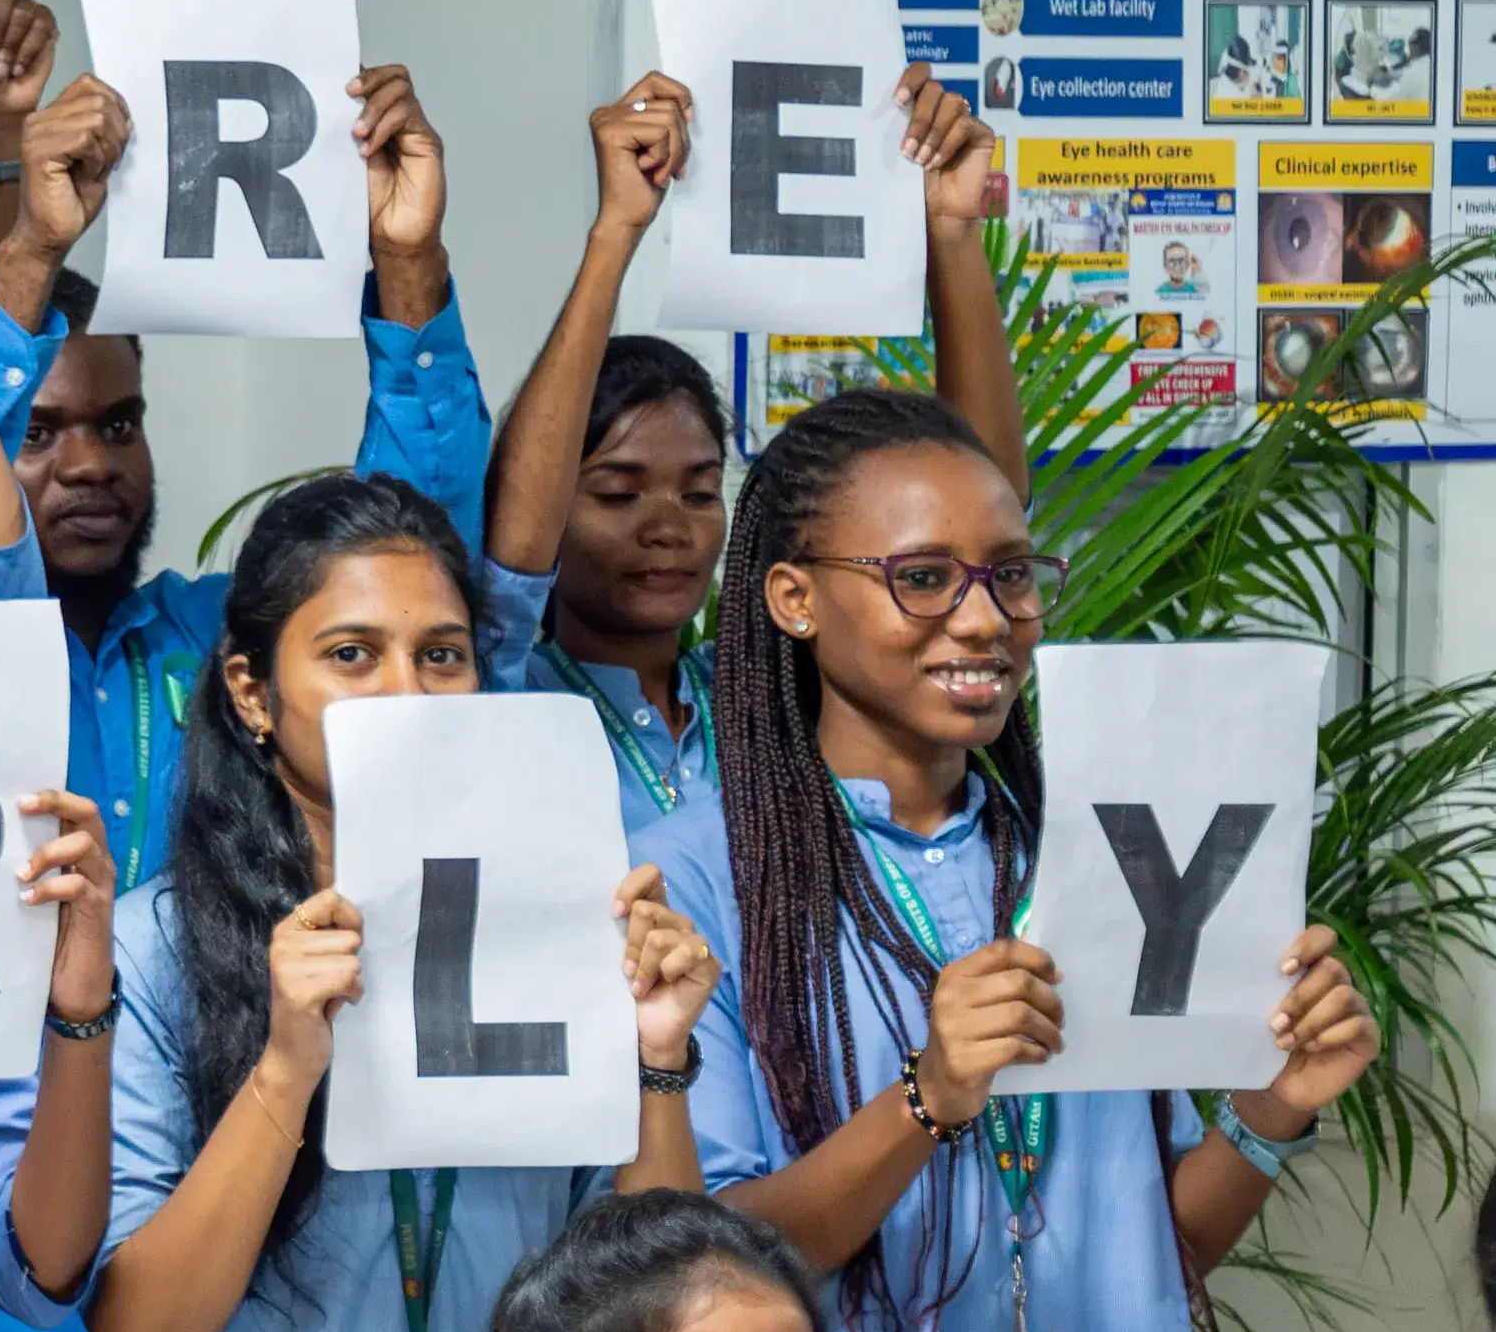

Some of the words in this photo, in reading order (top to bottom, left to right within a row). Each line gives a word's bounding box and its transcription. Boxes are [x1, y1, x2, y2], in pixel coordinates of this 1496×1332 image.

[1030, 75, 1055, 100] Eye
[1058, 75, 1127, 99] collection
[1129, 78, 1173, 100] center
[163, 60, 324, 259] R
[730, 60, 864, 259] E
[1061, 141, 1090, 161] Eye
[1096, 141, 1151, 159] health
[1156, 143, 1193, 158] care
[1275, 156, 1336, 176] Clinical
[1340, 158, 1418, 180] expertise
[1037, 172, 1129, 185] awareness
[1134, 171, 1217, 190] programs
[1092, 803, 1277, 1017] Y
[413, 858, 569, 1077] L
[1028, 1101, 1043, 1147] GITAM
